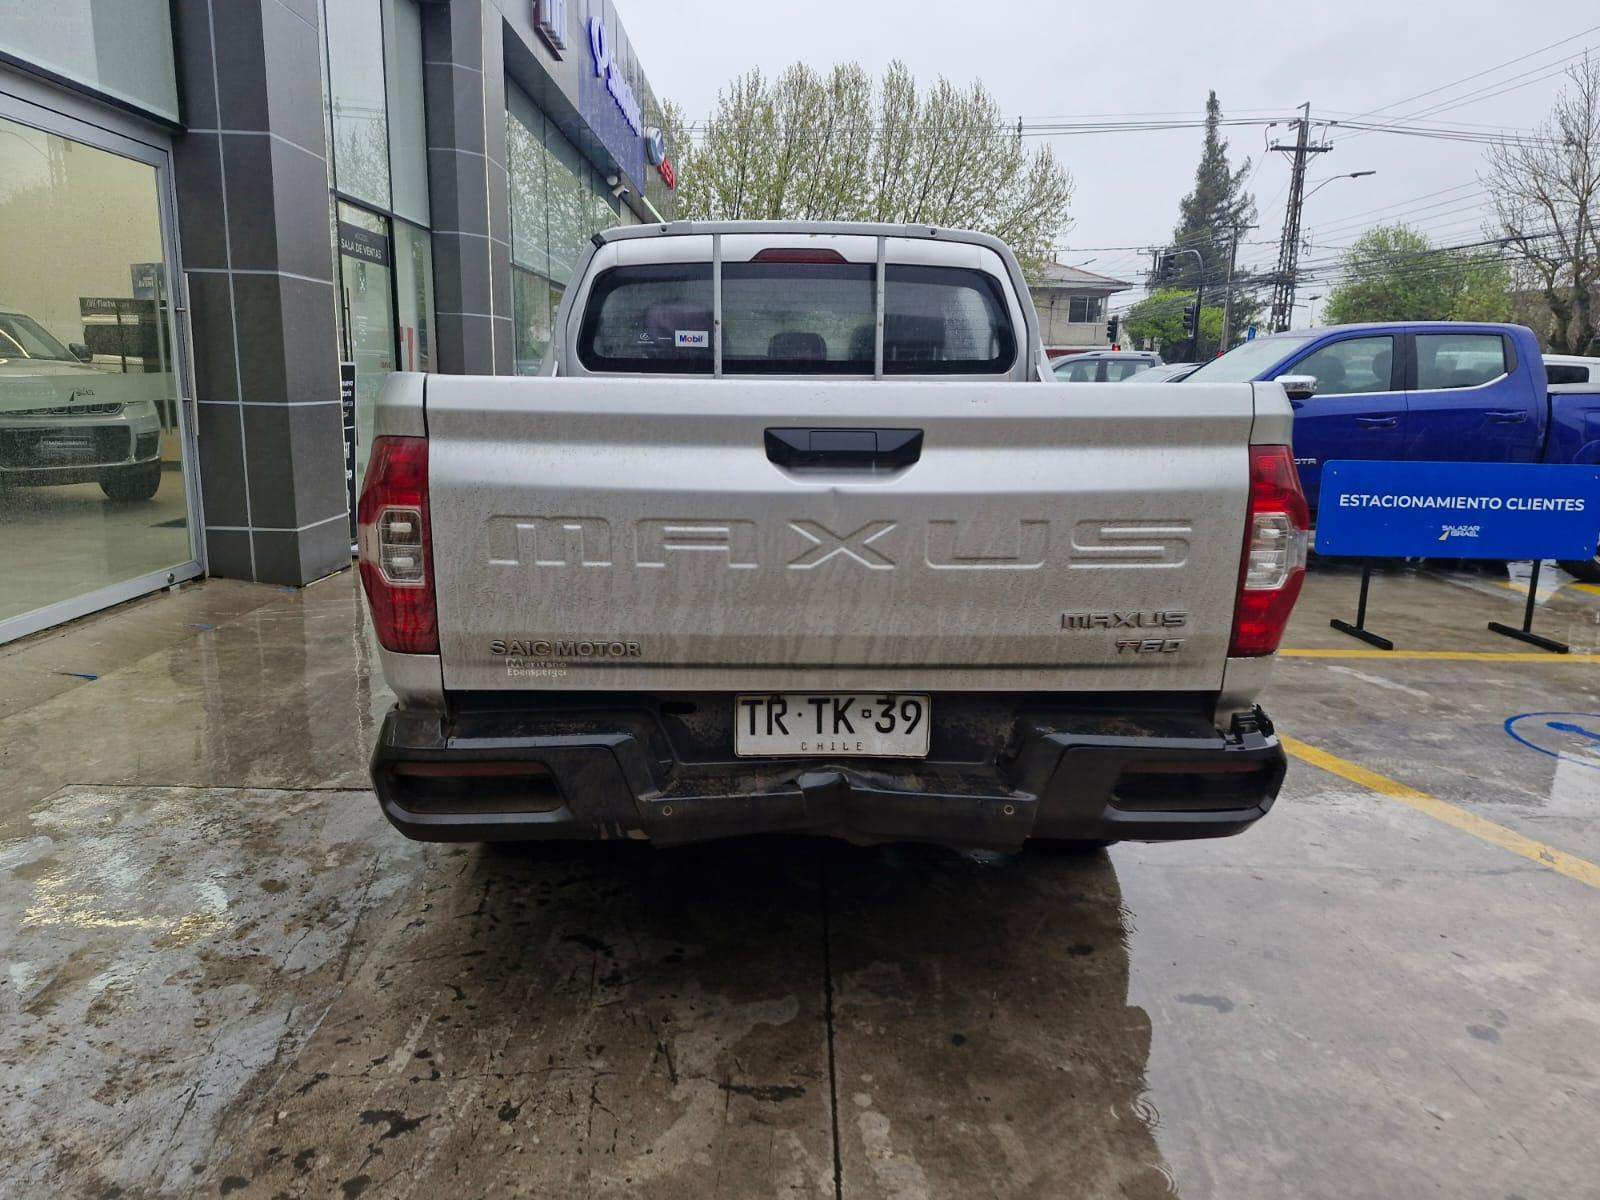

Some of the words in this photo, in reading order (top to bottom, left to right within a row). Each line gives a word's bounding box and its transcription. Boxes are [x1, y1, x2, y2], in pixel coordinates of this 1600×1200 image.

[340, 238, 355, 251] SALA
[356, 243, 363, 253] DE
[363, 245, 382, 259] VENTAS
[679, 334, 703, 343] Mobil
[1339, 494, 1502, 510] ESTACIONAMIENTO
[1506, 497, 1585, 512] CLIENTES
[486, 515, 1193, 571] MAXUS
[1062, 611, 1188, 629] MAXUS
[489, 640, 550, 657] SAIC
[555, 640, 642, 657] MOTOR
[801, 742, 864, 751] CHILE
